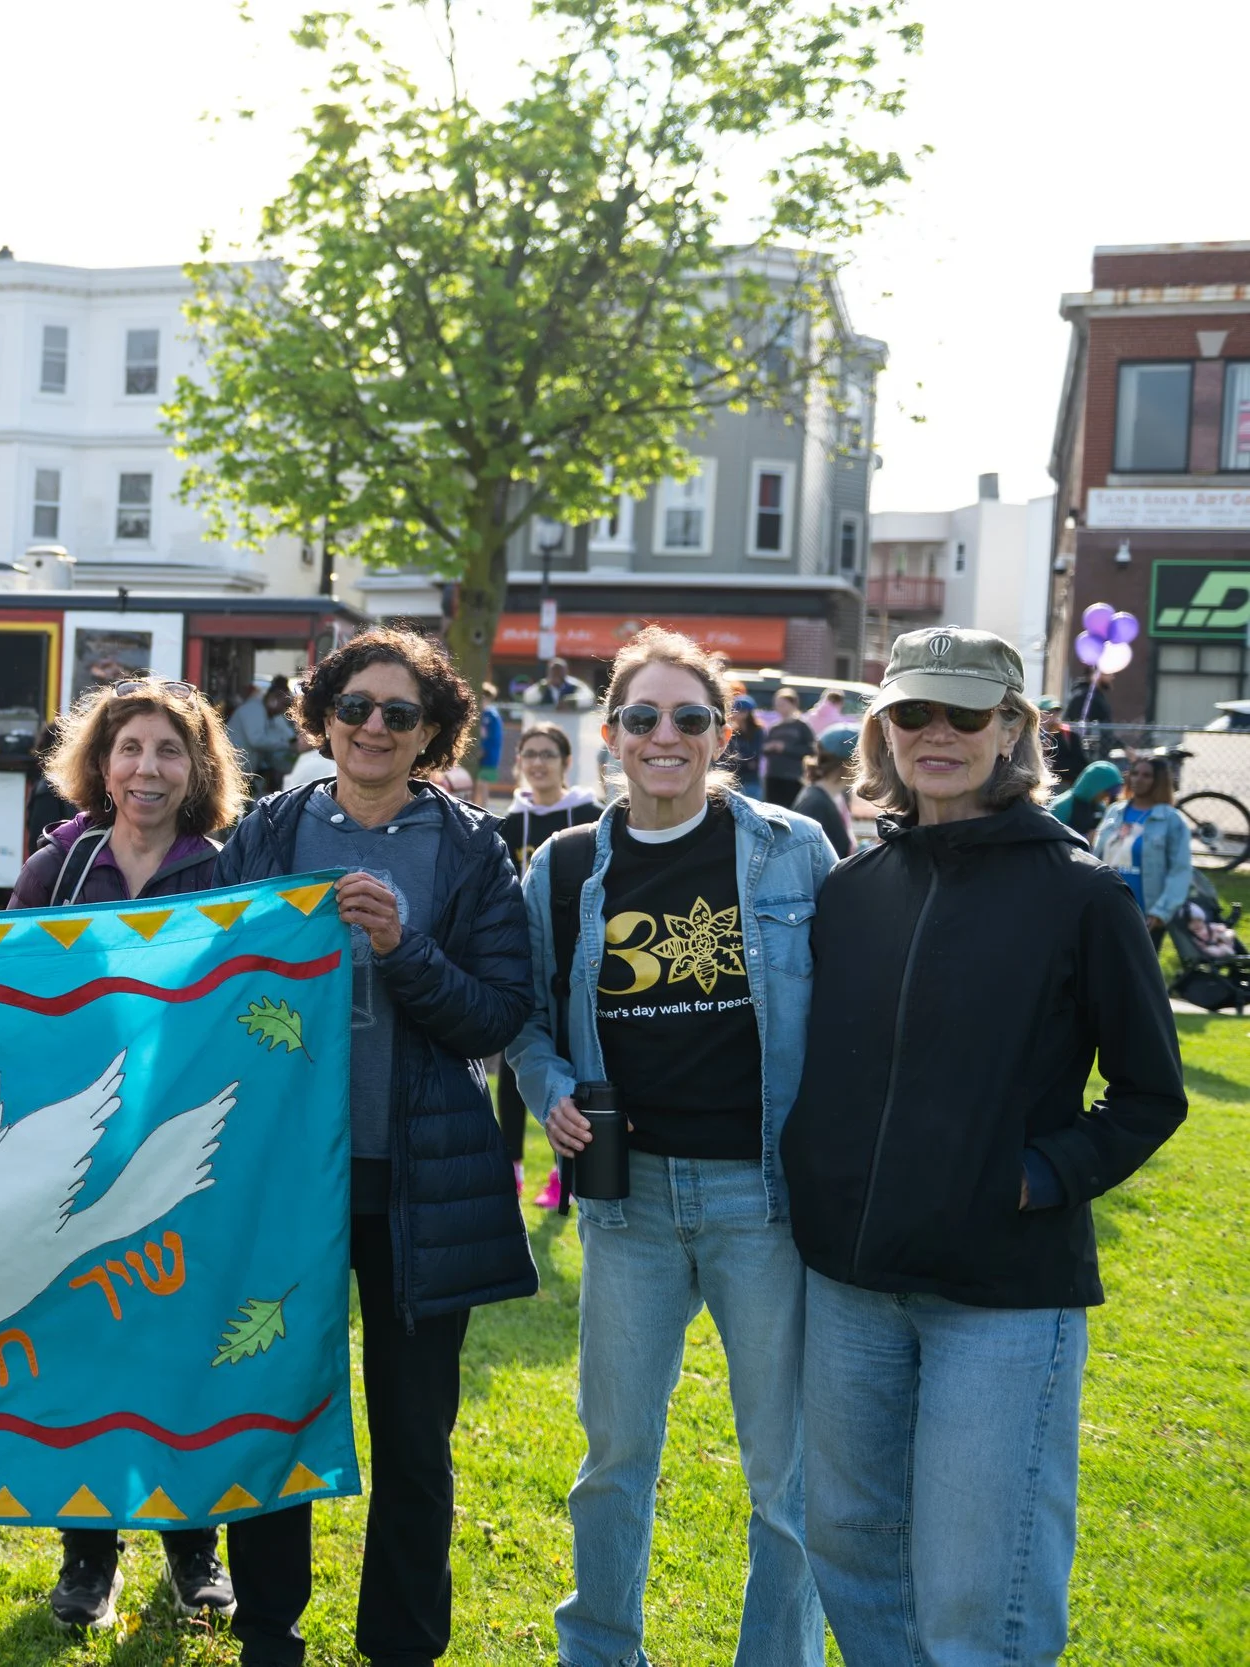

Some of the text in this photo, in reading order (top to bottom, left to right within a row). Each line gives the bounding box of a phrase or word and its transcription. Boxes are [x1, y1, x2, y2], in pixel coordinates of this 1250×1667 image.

[597, 1006, 630, 1019] ther's
[632, 1004, 656, 1018] day
[659, 1001, 692, 1014] walk
[694, 1000, 714, 1012] for
[69, 1231, 187, 1321] שיר
